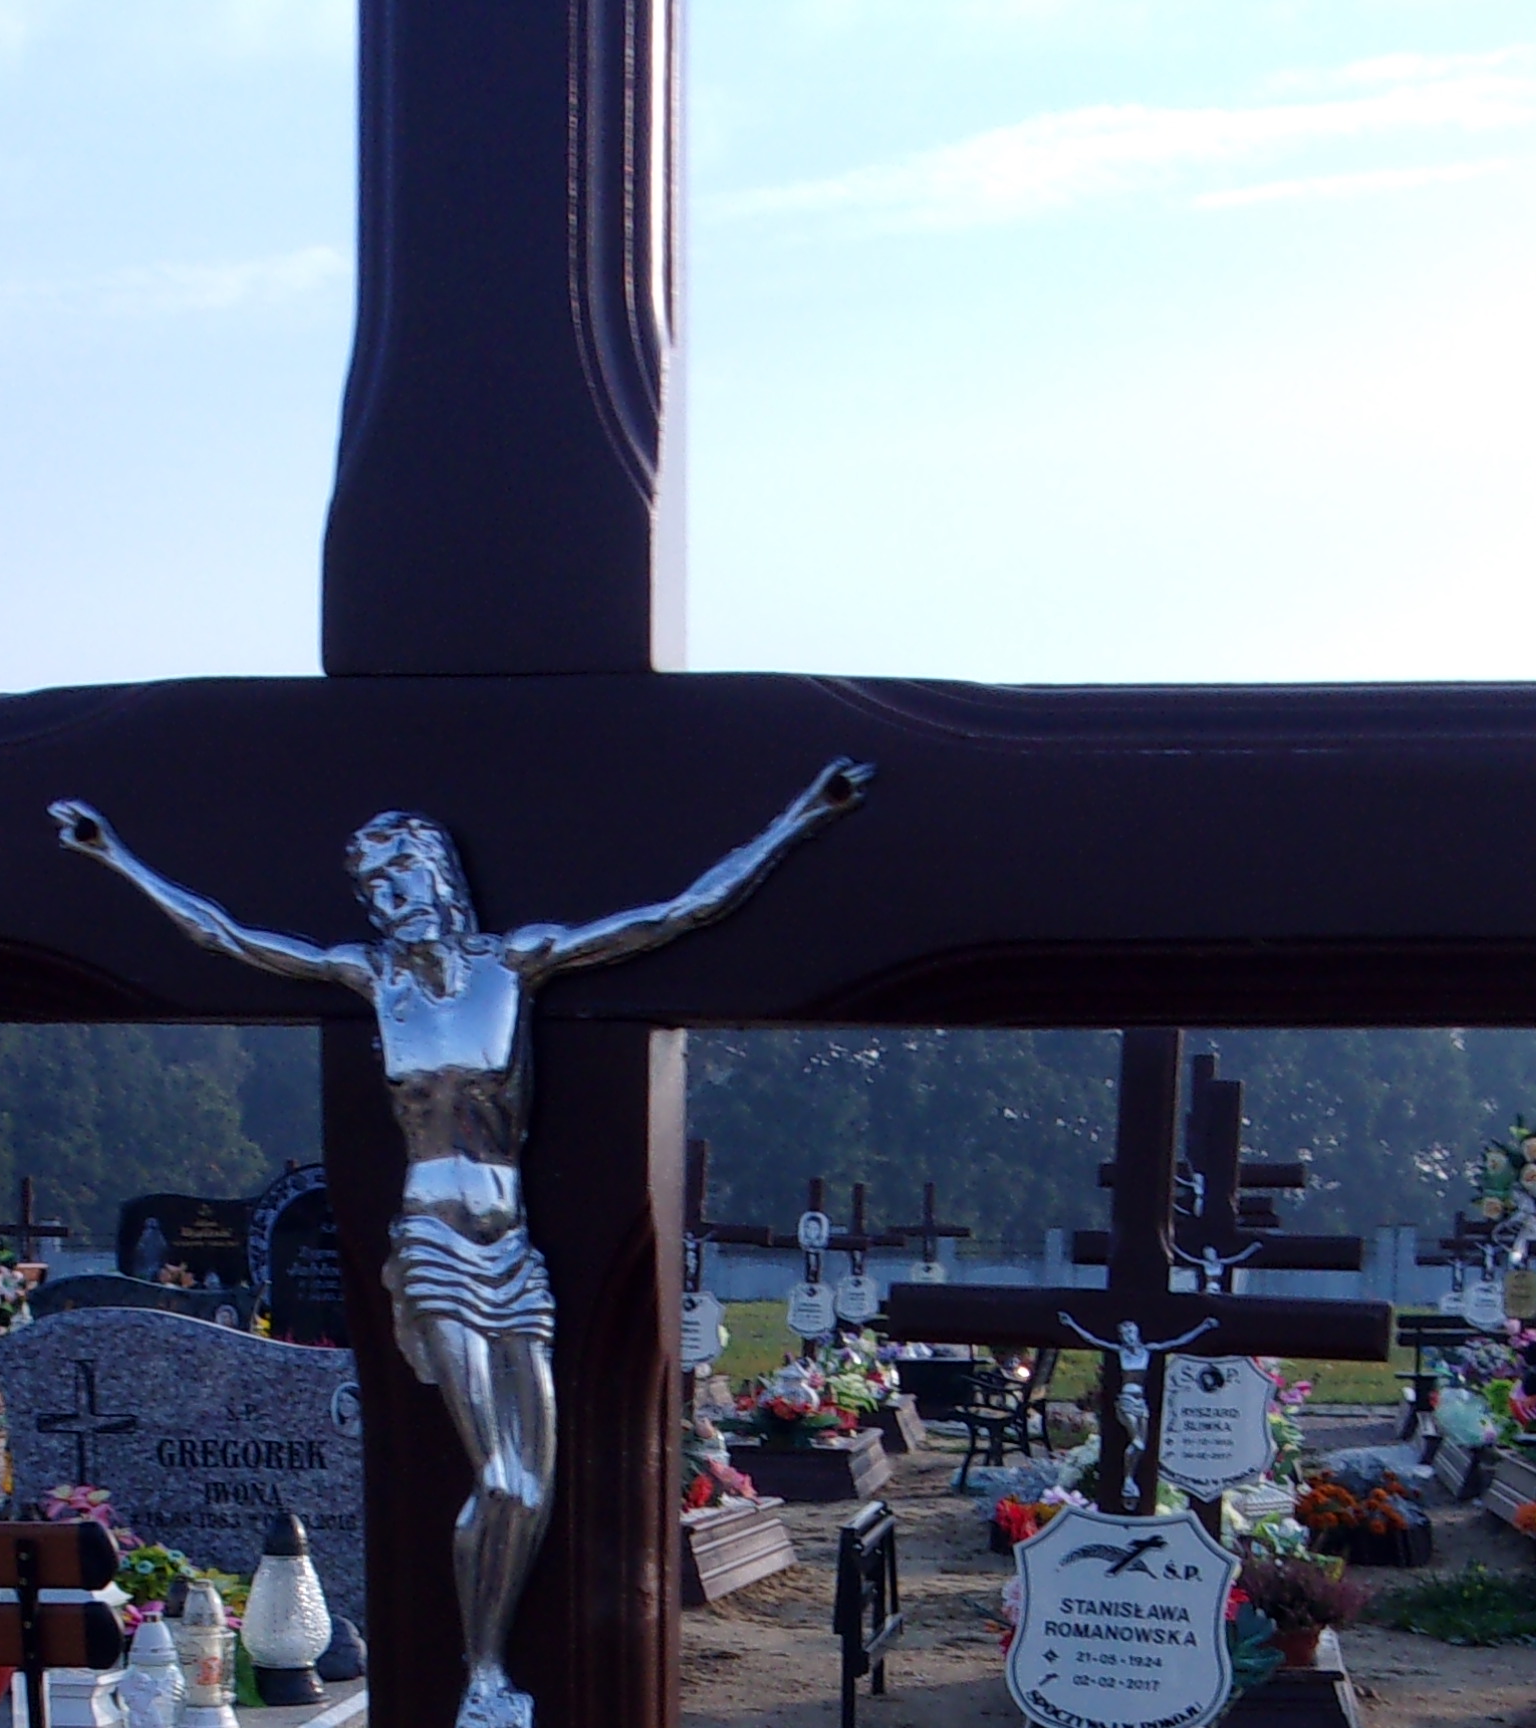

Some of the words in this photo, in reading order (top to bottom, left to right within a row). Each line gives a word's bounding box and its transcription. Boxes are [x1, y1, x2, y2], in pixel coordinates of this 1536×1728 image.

[156, 1439, 328, 1470] GREGOREK
[1060, 1598, 1191, 1623] STANISŁAWA
[1044, 1620, 1197, 1647] ROMANOWSKA
